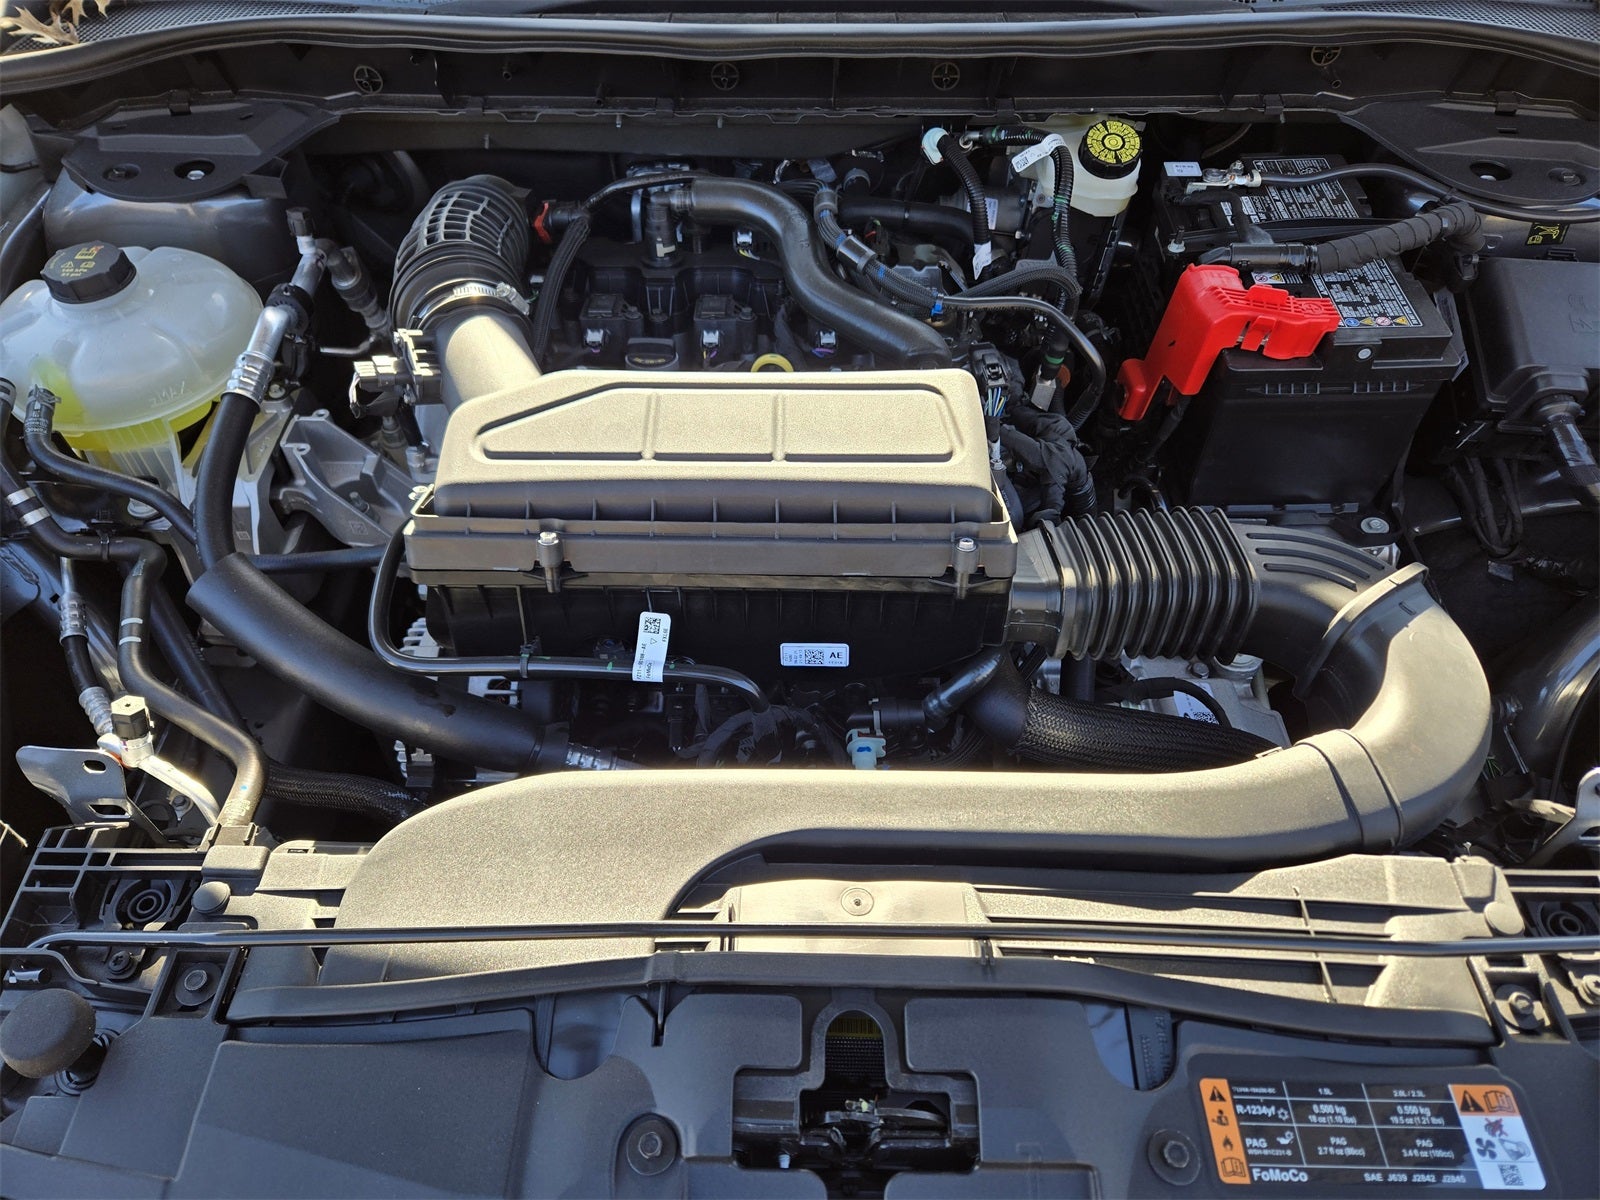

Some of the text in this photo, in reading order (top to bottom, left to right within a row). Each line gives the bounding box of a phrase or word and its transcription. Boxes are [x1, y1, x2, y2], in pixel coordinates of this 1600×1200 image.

[829, 651, 843, 659] AE
[1236, 1104, 1276, 1118] R-1234yf
[1335, 1105, 1347, 1116] kg
[1419, 1106, 1431, 1117] kg
[1245, 1138, 1268, 1148] PAG
[1330, 1136, 1347, 1146] PAG
[1416, 1139, 1433, 1148] PAG
[1252, 1168, 1308, 1182] FoMoCo
[1363, 1173, 1383, 1182] SAE
[1387, 1173, 1408, 1182] J639
[1412, 1174, 1437, 1183] J2842
